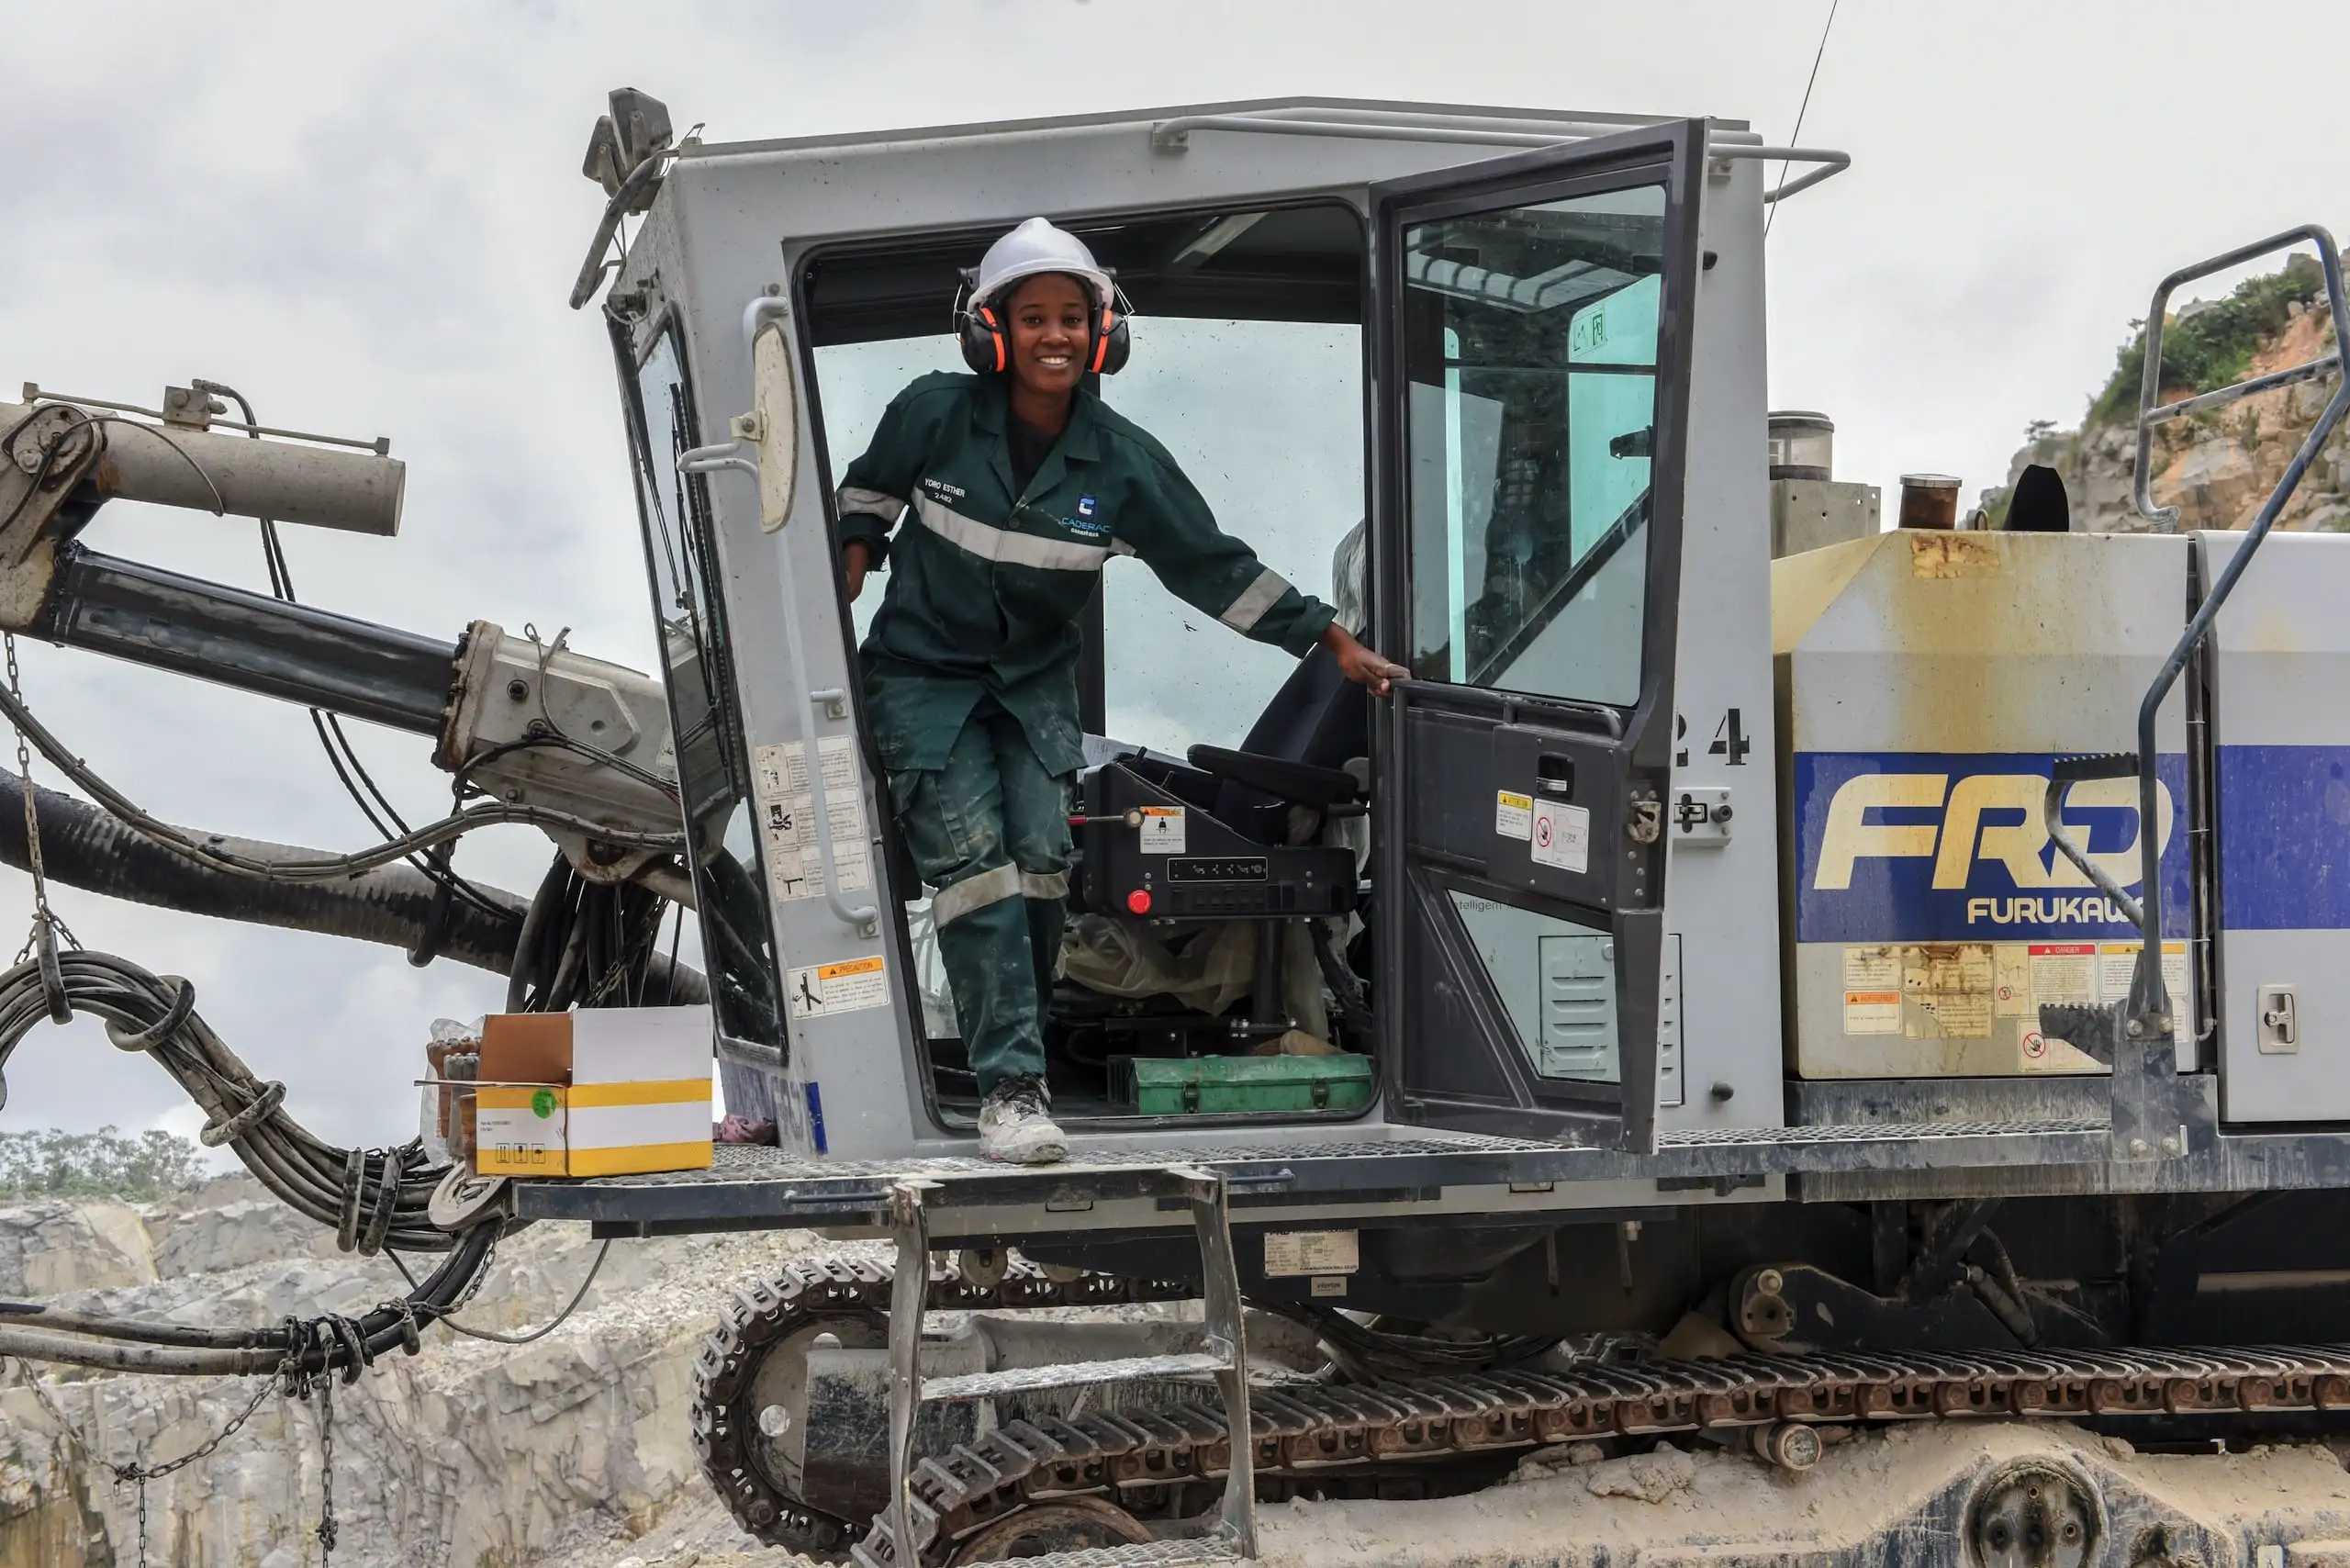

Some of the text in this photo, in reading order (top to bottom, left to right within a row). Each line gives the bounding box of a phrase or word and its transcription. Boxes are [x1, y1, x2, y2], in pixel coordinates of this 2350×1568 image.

[924, 477, 966, 498] YORO ESTHER
[1061, 517, 1111, 533] CADERAC
[1967, 897, 2144, 924] FURUKAW
[839, 961, 873, 973] PRECAUTION
